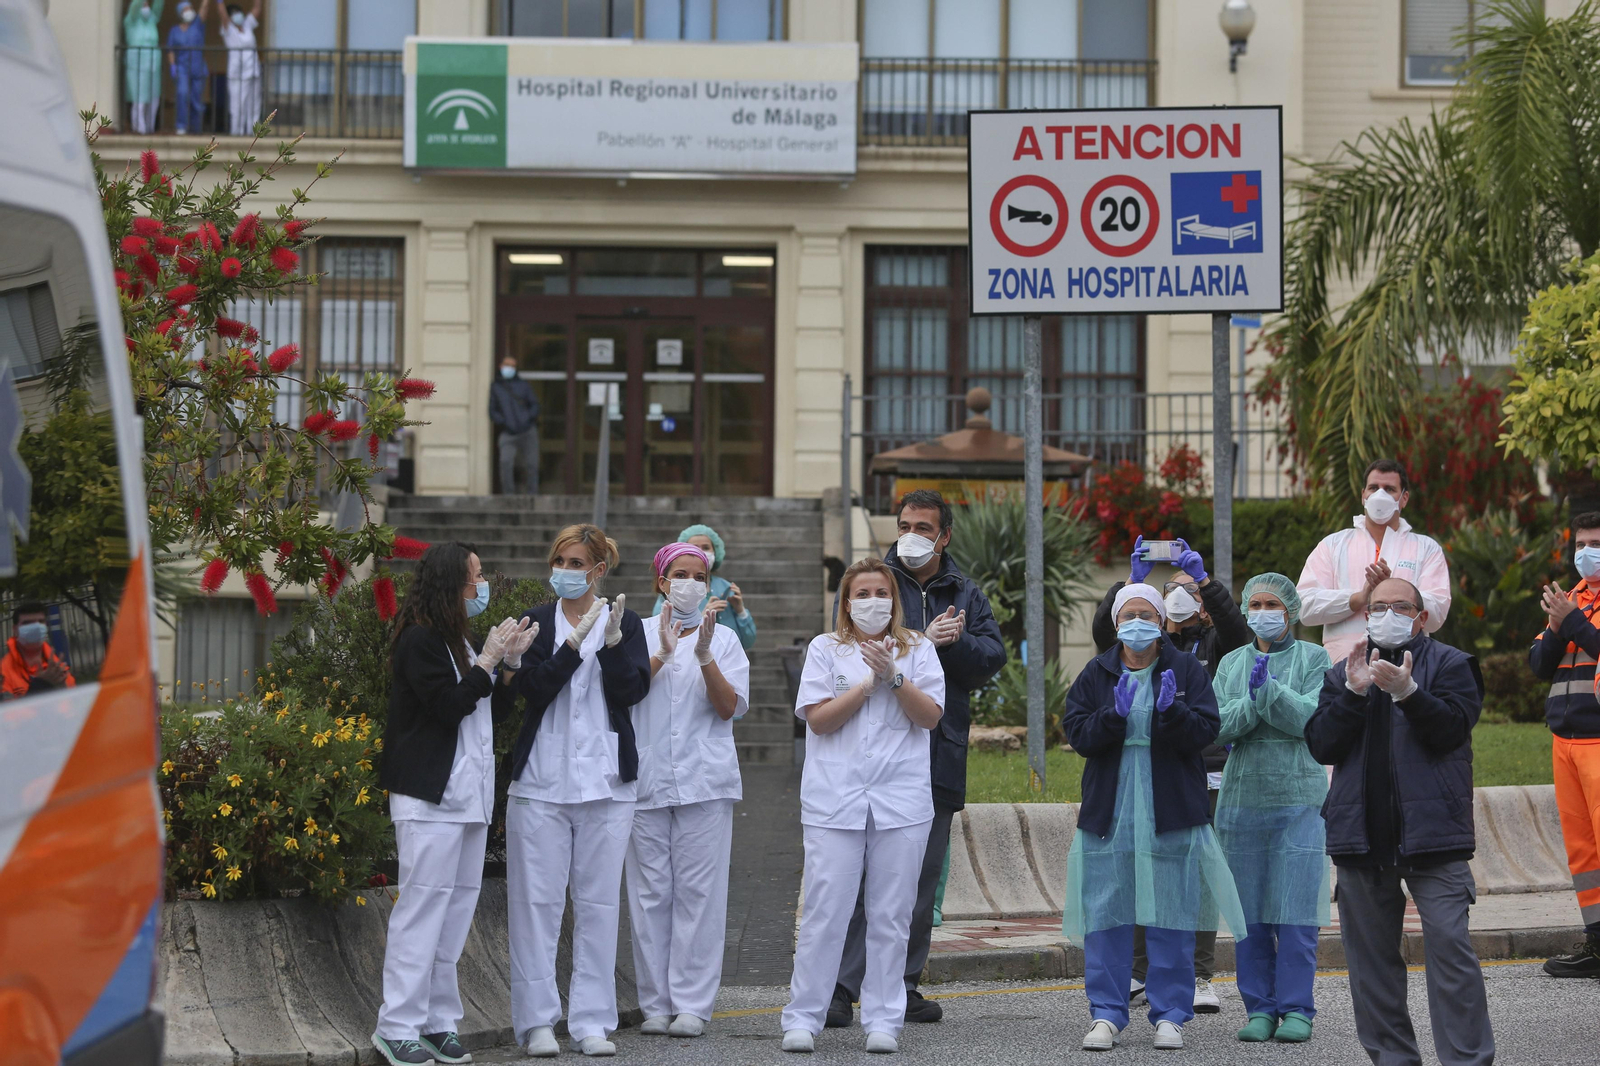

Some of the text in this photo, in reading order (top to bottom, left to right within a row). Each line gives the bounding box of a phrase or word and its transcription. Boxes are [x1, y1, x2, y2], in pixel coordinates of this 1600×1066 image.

[517, 78, 838, 101] Hospital Regional Universitario
[732, 108, 838, 129] de Málaga
[597, 131, 665, 148] Pabellón
[707, 136, 772, 153] Hospital
[777, 137, 838, 152] General
[1012, 123, 1241, 161] ATENCION
[1099, 196, 1141, 232] 20
[987, 264, 1250, 300] ZONA HOSPITALARIA
